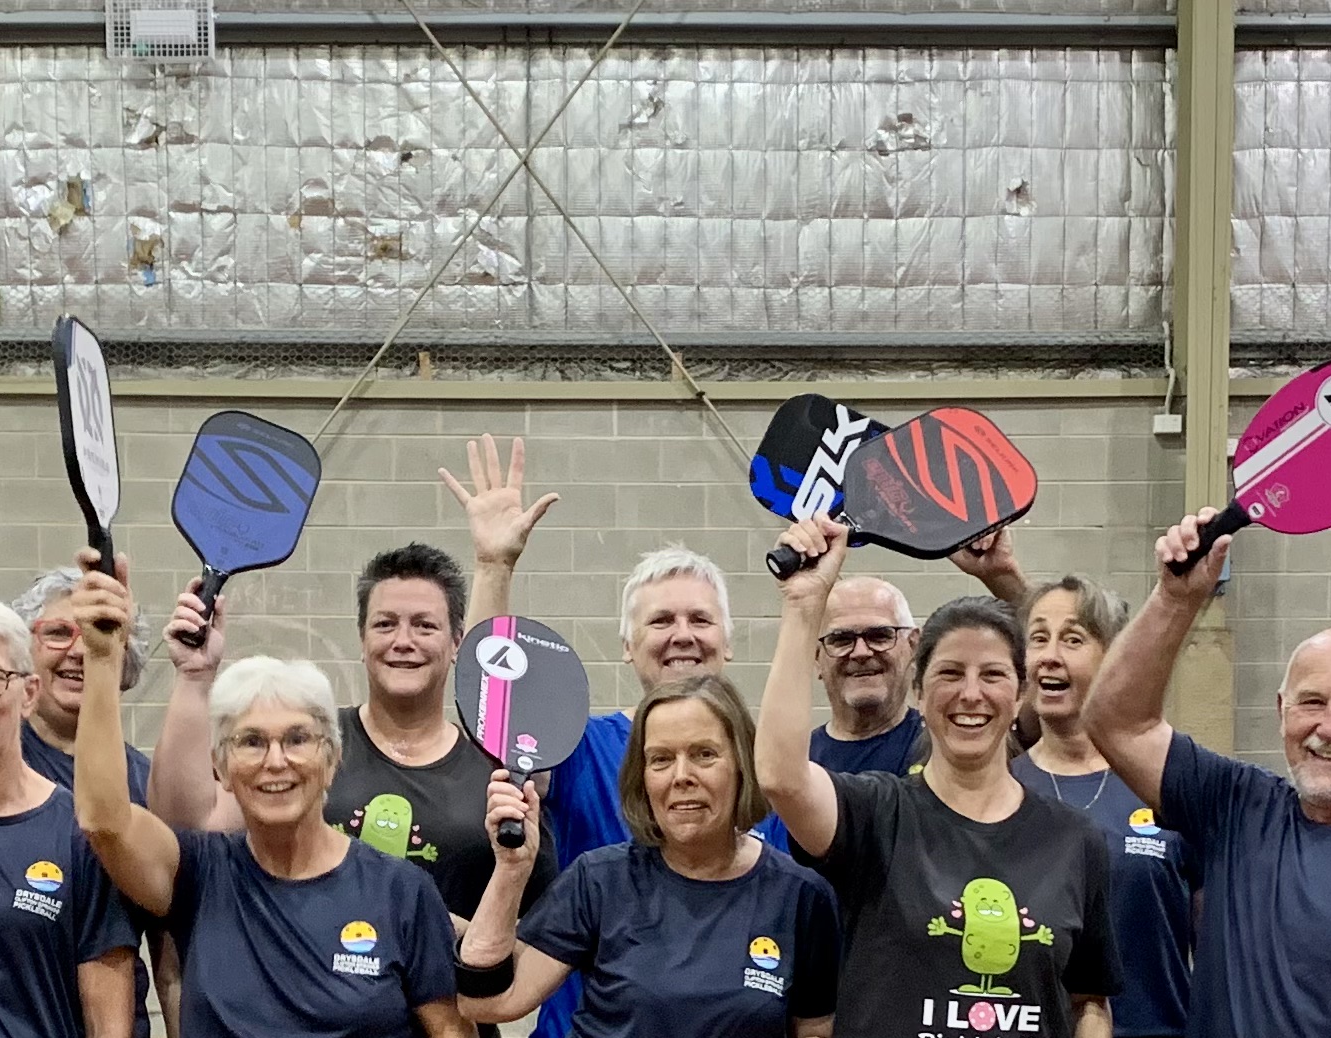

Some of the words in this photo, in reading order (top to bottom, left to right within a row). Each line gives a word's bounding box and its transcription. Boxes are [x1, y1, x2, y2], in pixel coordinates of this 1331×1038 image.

[790, 403, 870, 521] SLK
[16, 889, 62, 909] DRYSDALE
[922, 999, 934, 1026] I
